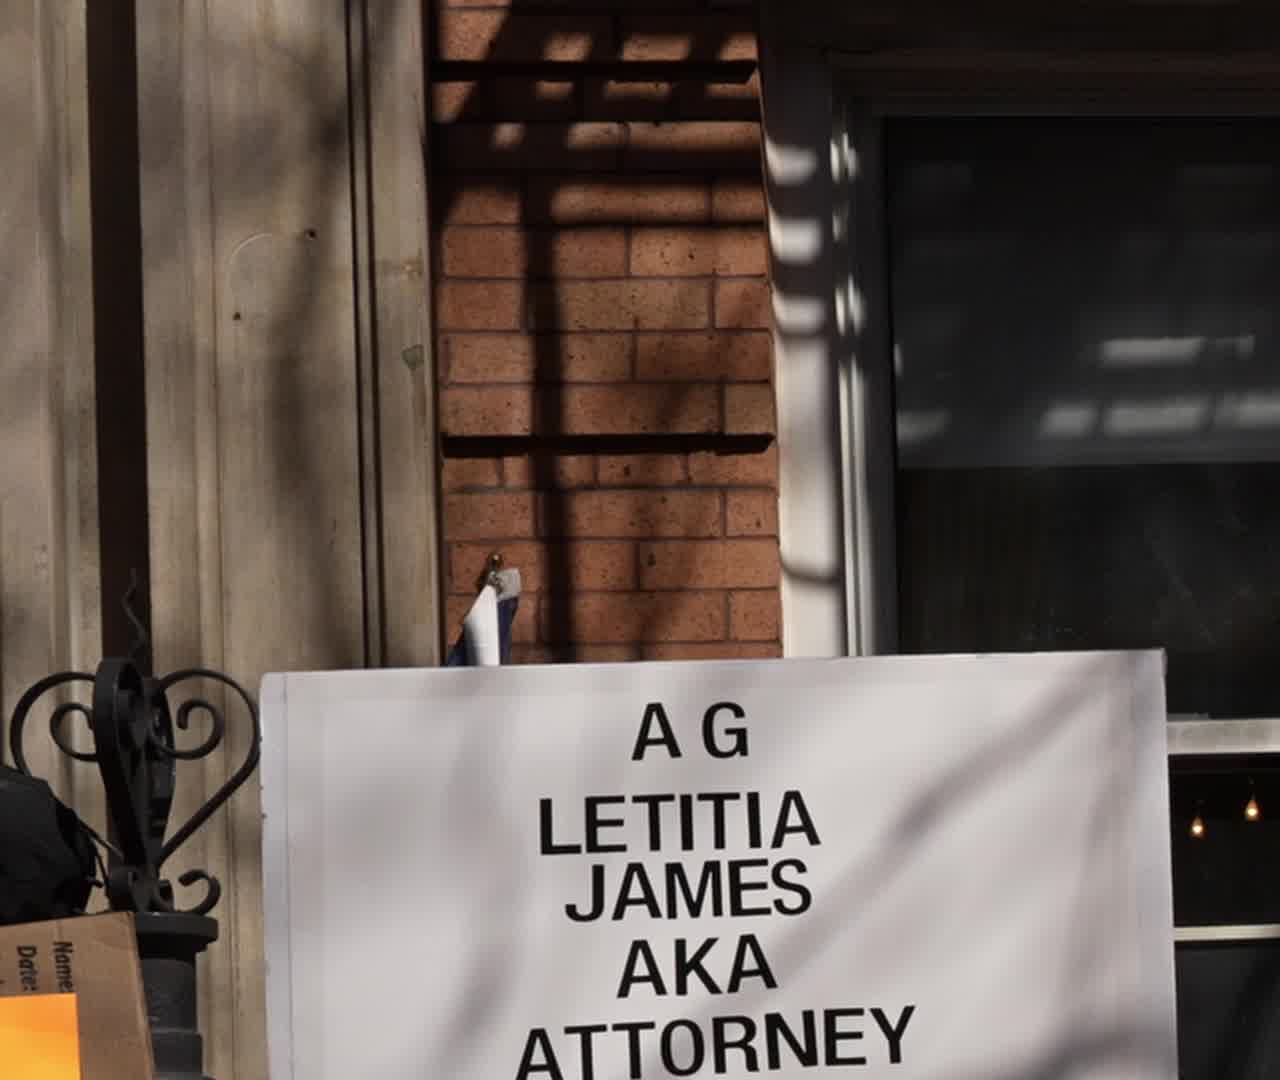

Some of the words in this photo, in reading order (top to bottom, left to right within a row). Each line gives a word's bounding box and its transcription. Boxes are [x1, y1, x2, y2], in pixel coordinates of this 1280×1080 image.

[540, 790, 821, 855] LETITIA
[565, 858, 812, 922] JAMES
[16, 945, 38, 991] Date:
[617, 934, 778, 998] AKA
